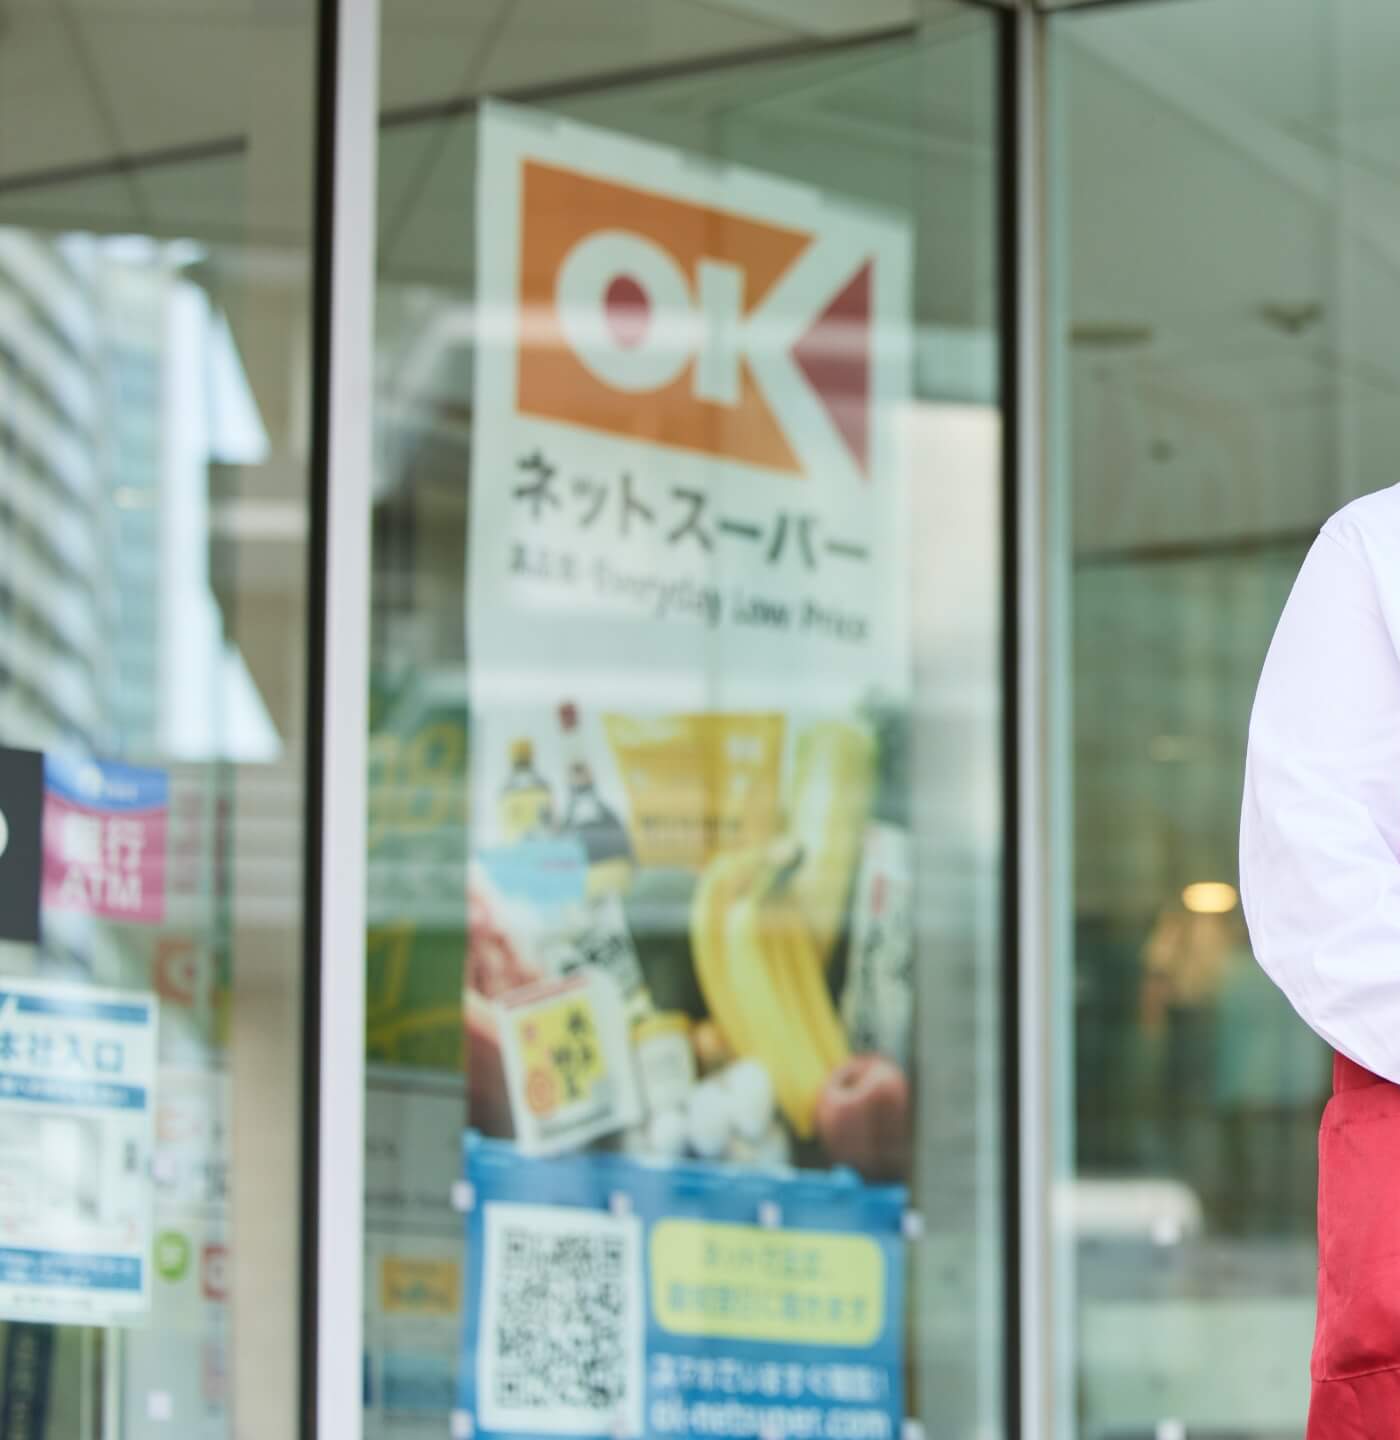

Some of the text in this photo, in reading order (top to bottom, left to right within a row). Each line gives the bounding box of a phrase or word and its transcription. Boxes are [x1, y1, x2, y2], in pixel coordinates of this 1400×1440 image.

[555, 230, 869, 479] OK
[512, 446, 870, 569] ネットスーパー
[735, 598, 790, 632] Low
[61, 865, 143, 912] ATM
